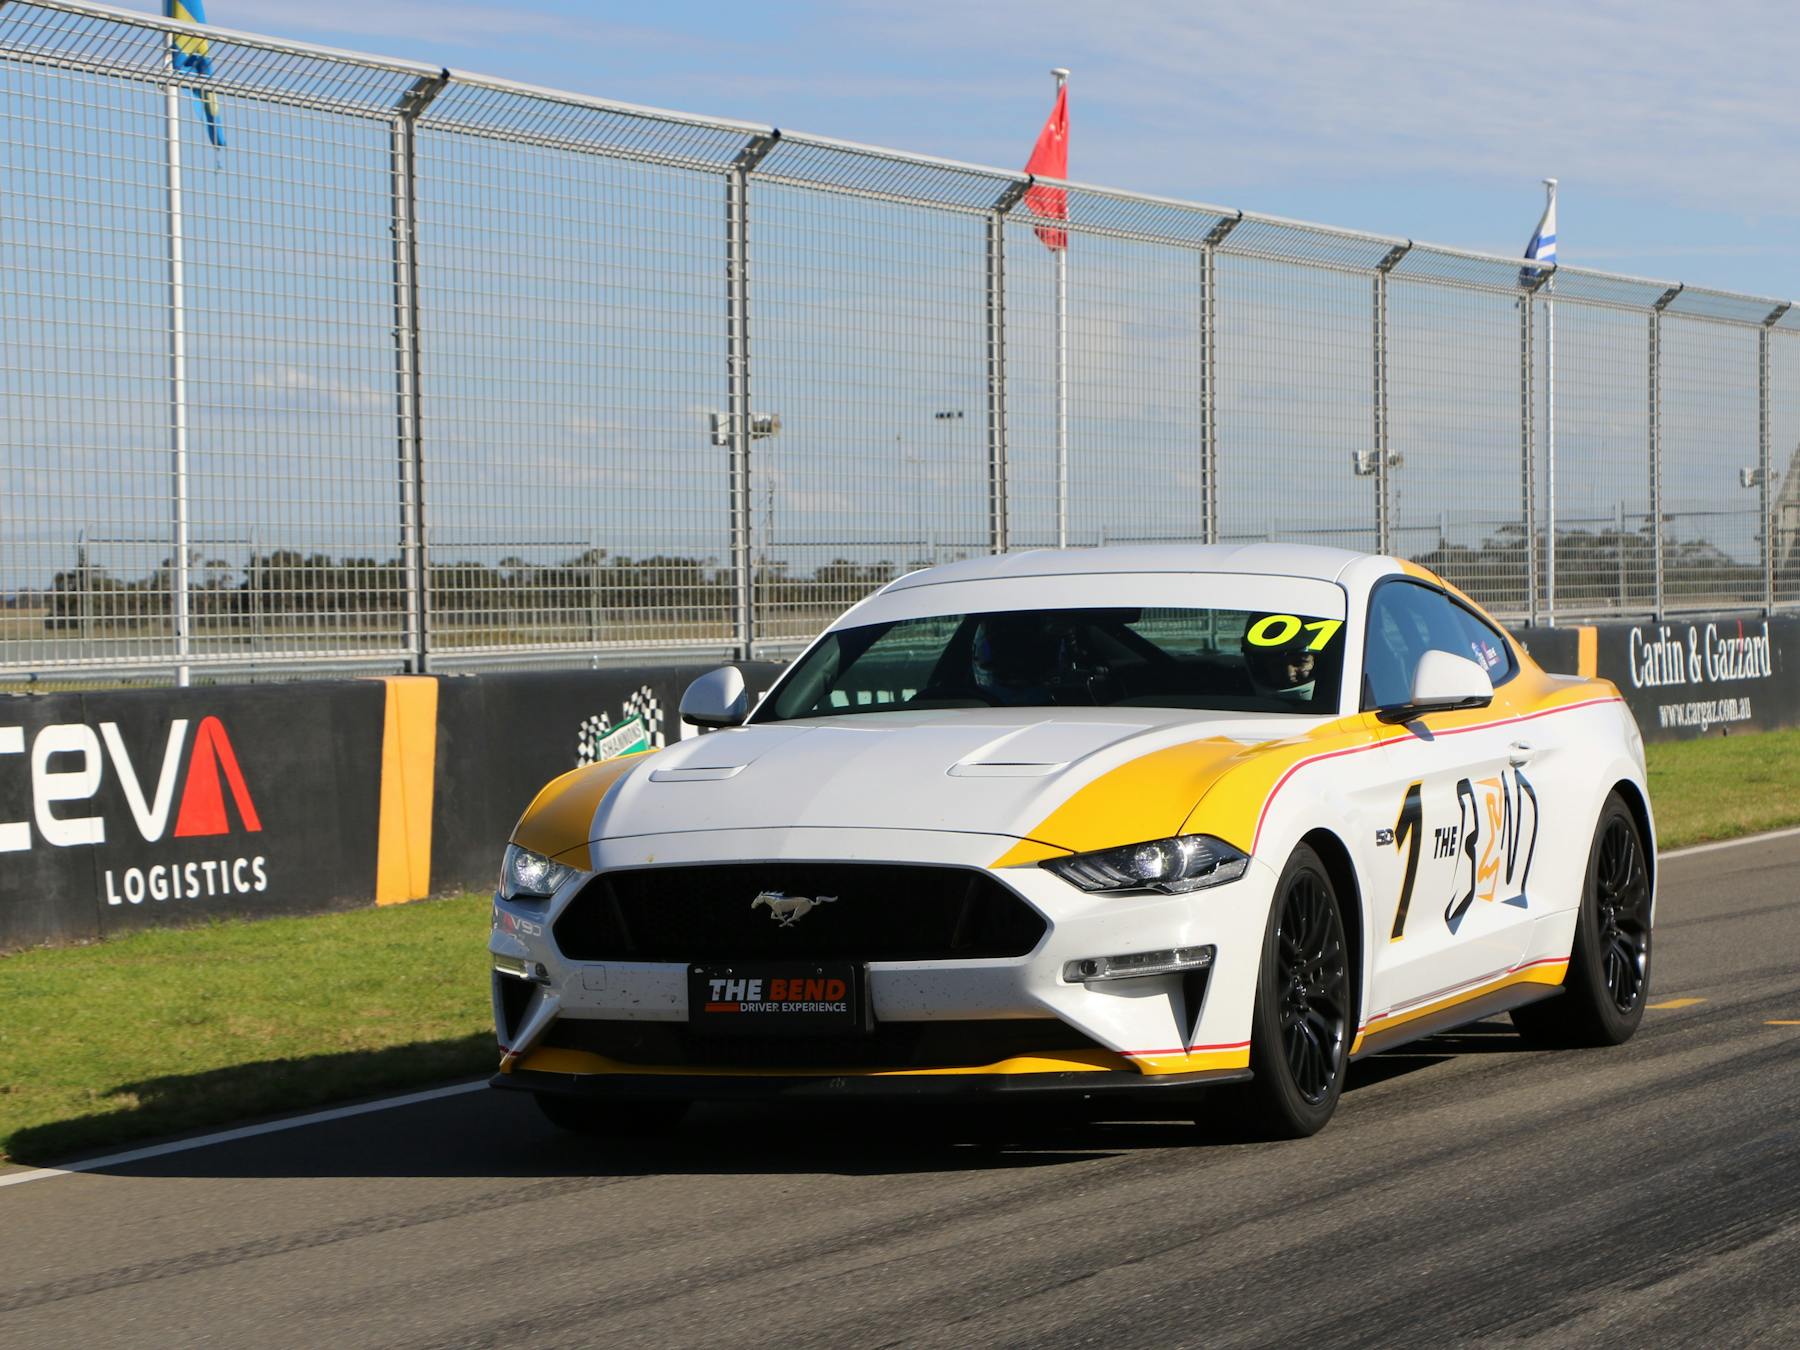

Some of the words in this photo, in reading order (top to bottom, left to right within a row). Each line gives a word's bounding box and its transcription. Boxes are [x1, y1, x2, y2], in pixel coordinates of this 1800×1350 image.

[1247, 614, 1344, 651] 01
[1630, 626, 1686, 689] Carlin
[1688, 626, 1703, 684] &
[1705, 618, 1772, 682] Gazzard
[1659, 697, 1752, 732] www.cargaz.com.au
[1434, 826, 1458, 859] THE
[1389, 779, 1424, 944] 1
[105, 856, 268, 905] LOGISTICS
[709, 979, 763, 1002] THE
[769, 979, 846, 1002] BEND
[740, 1002, 780, 1012] DRIVER
[781, 1002, 847, 1012] EXPERIENCE
